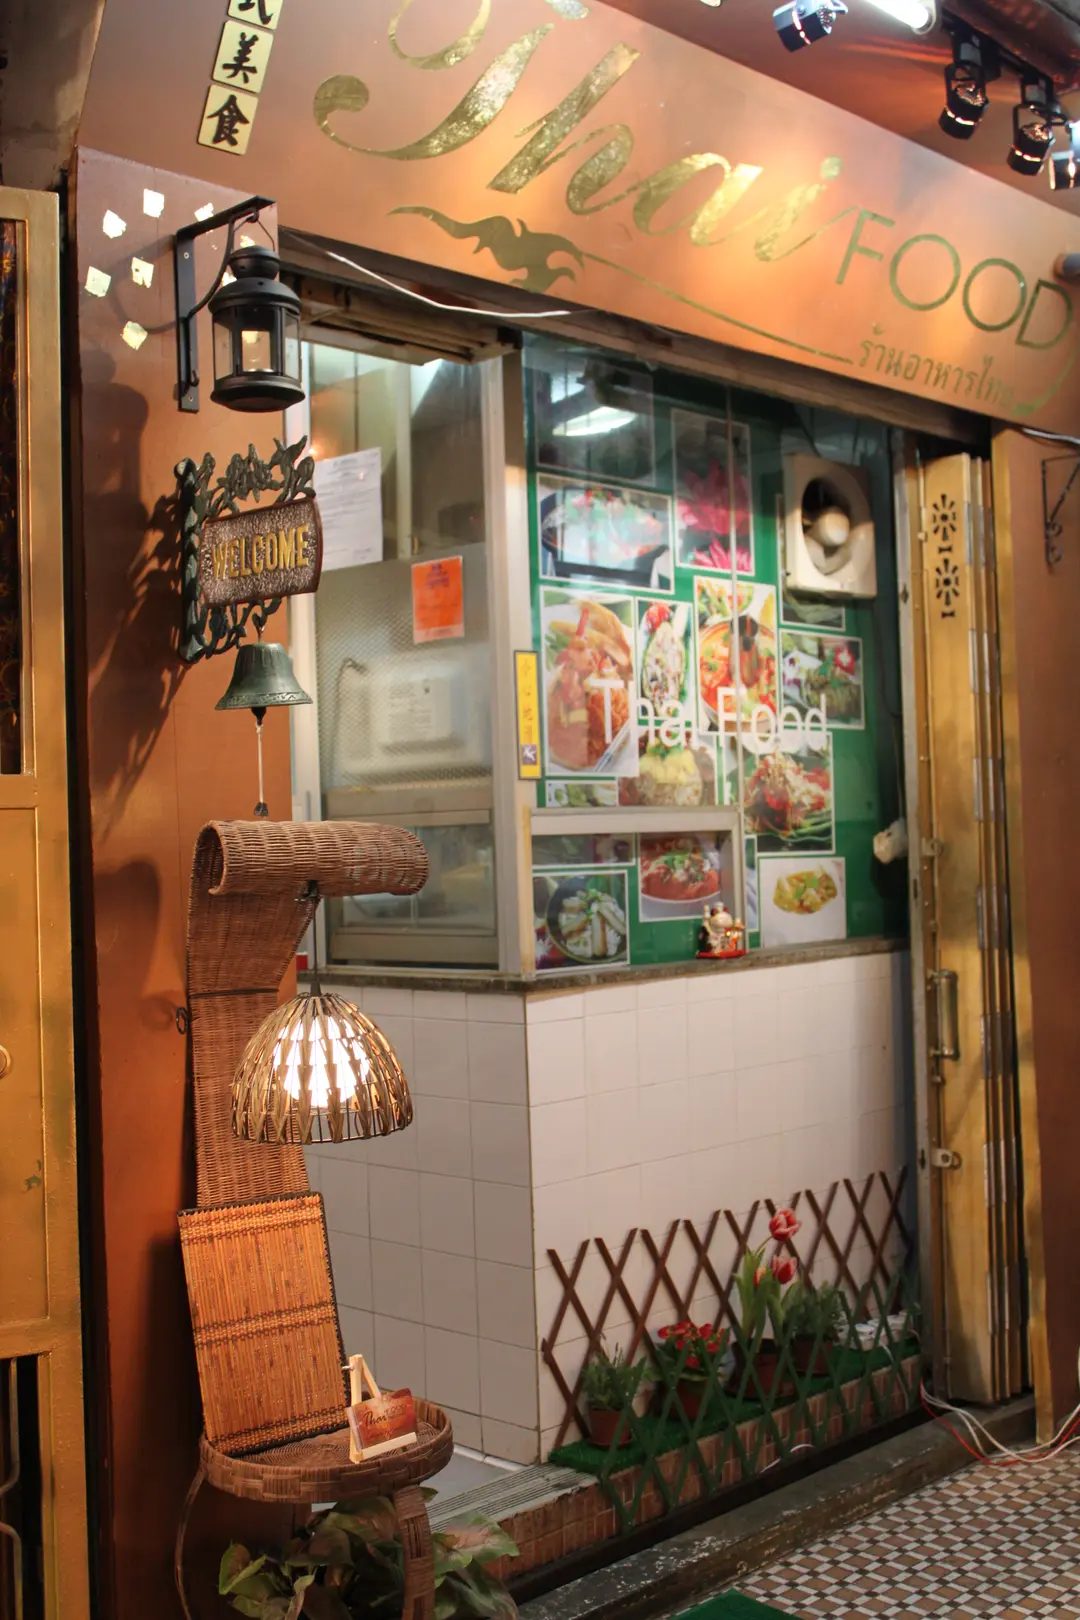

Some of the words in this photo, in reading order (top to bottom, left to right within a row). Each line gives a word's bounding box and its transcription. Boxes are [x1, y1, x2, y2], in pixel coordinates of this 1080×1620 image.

[834, 208, 1074, 351] FOOD
[211, 524, 309, 581] WELCOME
[717, 685, 827, 755] Food
